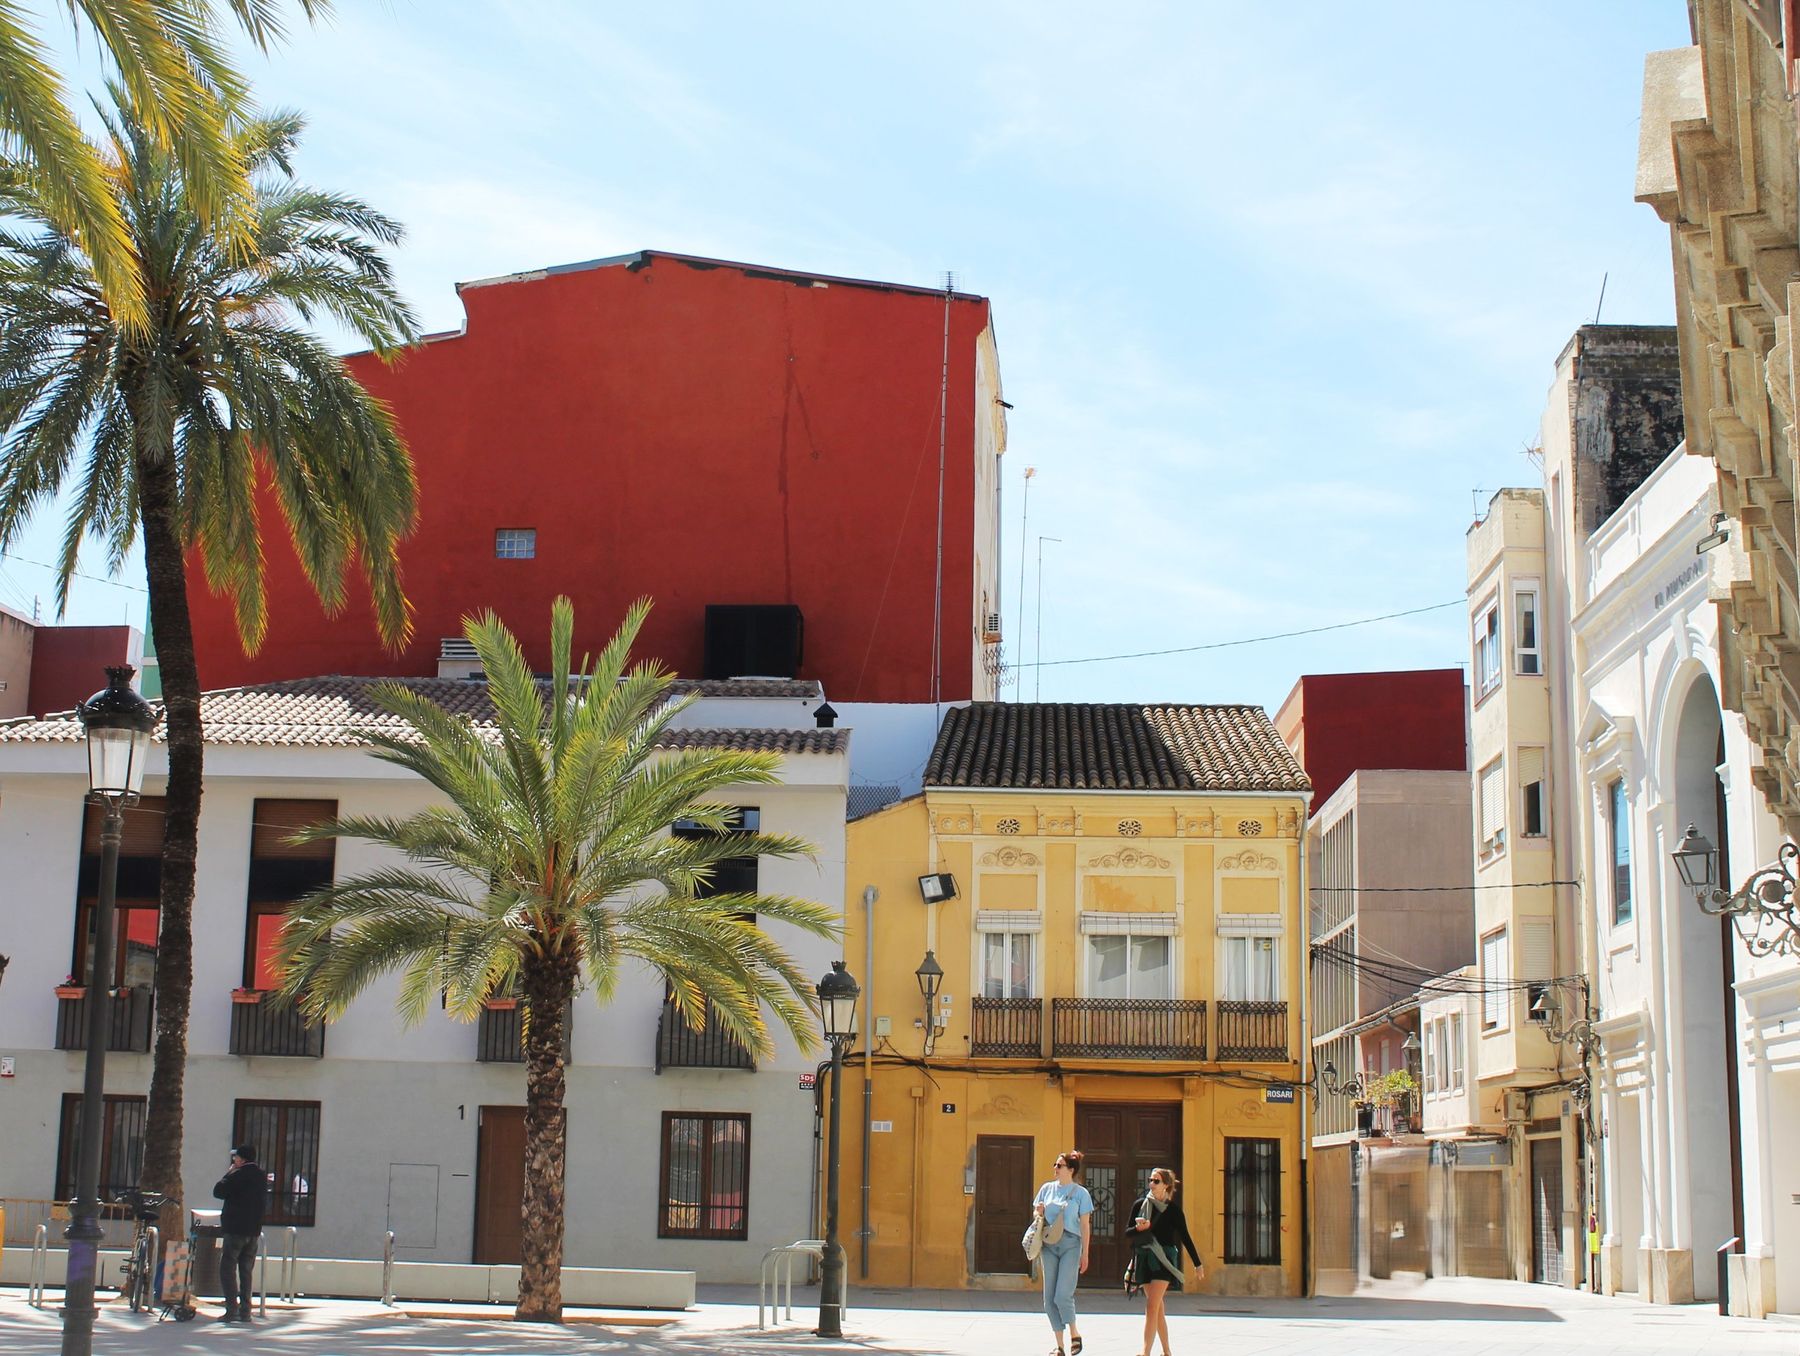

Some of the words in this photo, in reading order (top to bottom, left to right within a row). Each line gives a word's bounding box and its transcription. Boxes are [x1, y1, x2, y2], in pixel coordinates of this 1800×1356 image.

[800, 1074, 815, 1082] SDS
[1266, 1090, 1293, 1098] ROSARI
[458, 1104, 464, 1120] 1
[946, 1104, 952, 1112] 2
